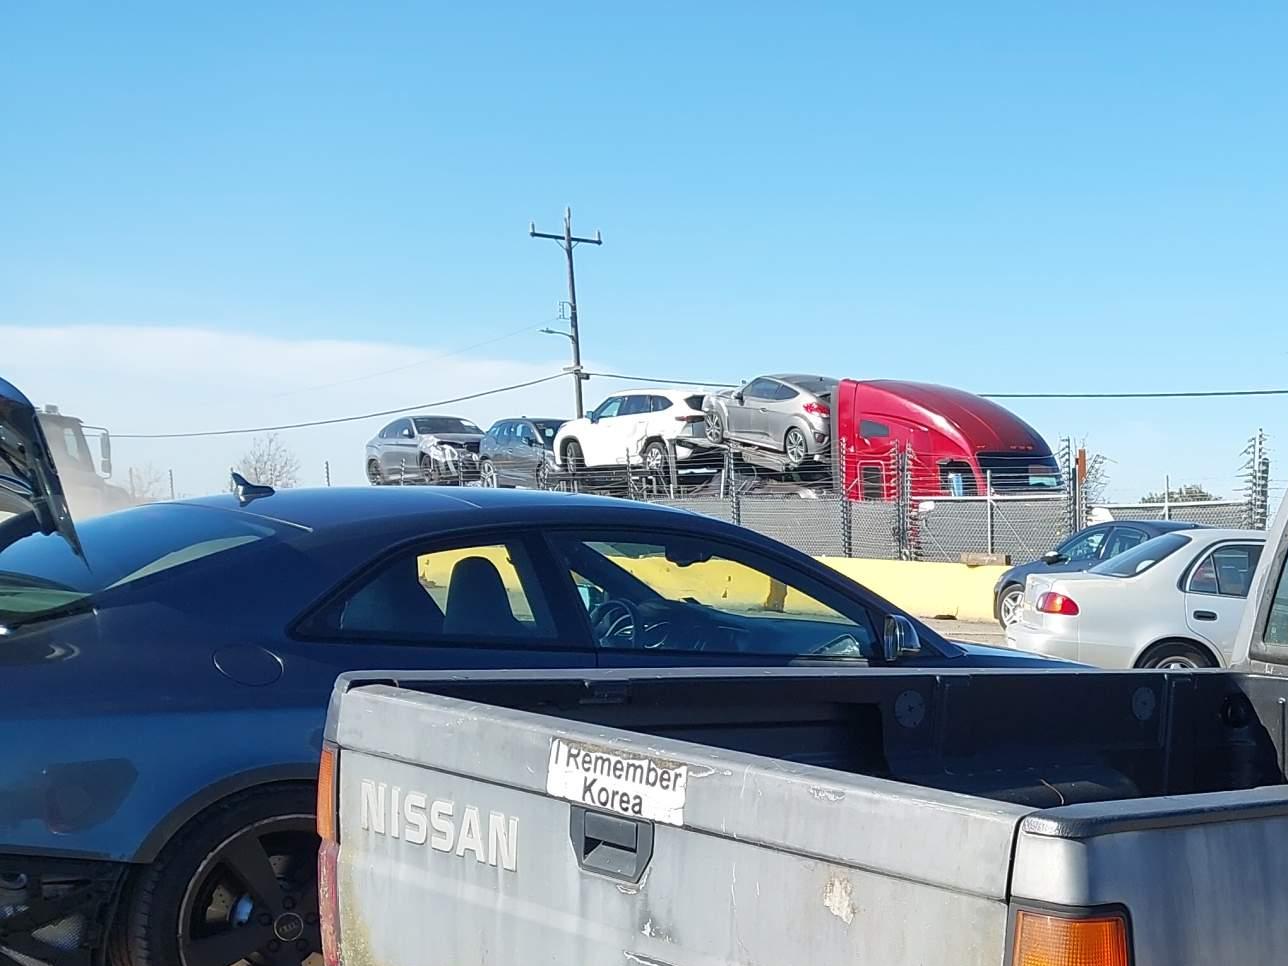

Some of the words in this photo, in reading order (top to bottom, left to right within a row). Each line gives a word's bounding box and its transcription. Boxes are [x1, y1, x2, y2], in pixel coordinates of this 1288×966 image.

[566, 746, 683, 792] Remember
[582, 776, 644, 815] Korea
[360, 779, 520, 872] NISSAN
